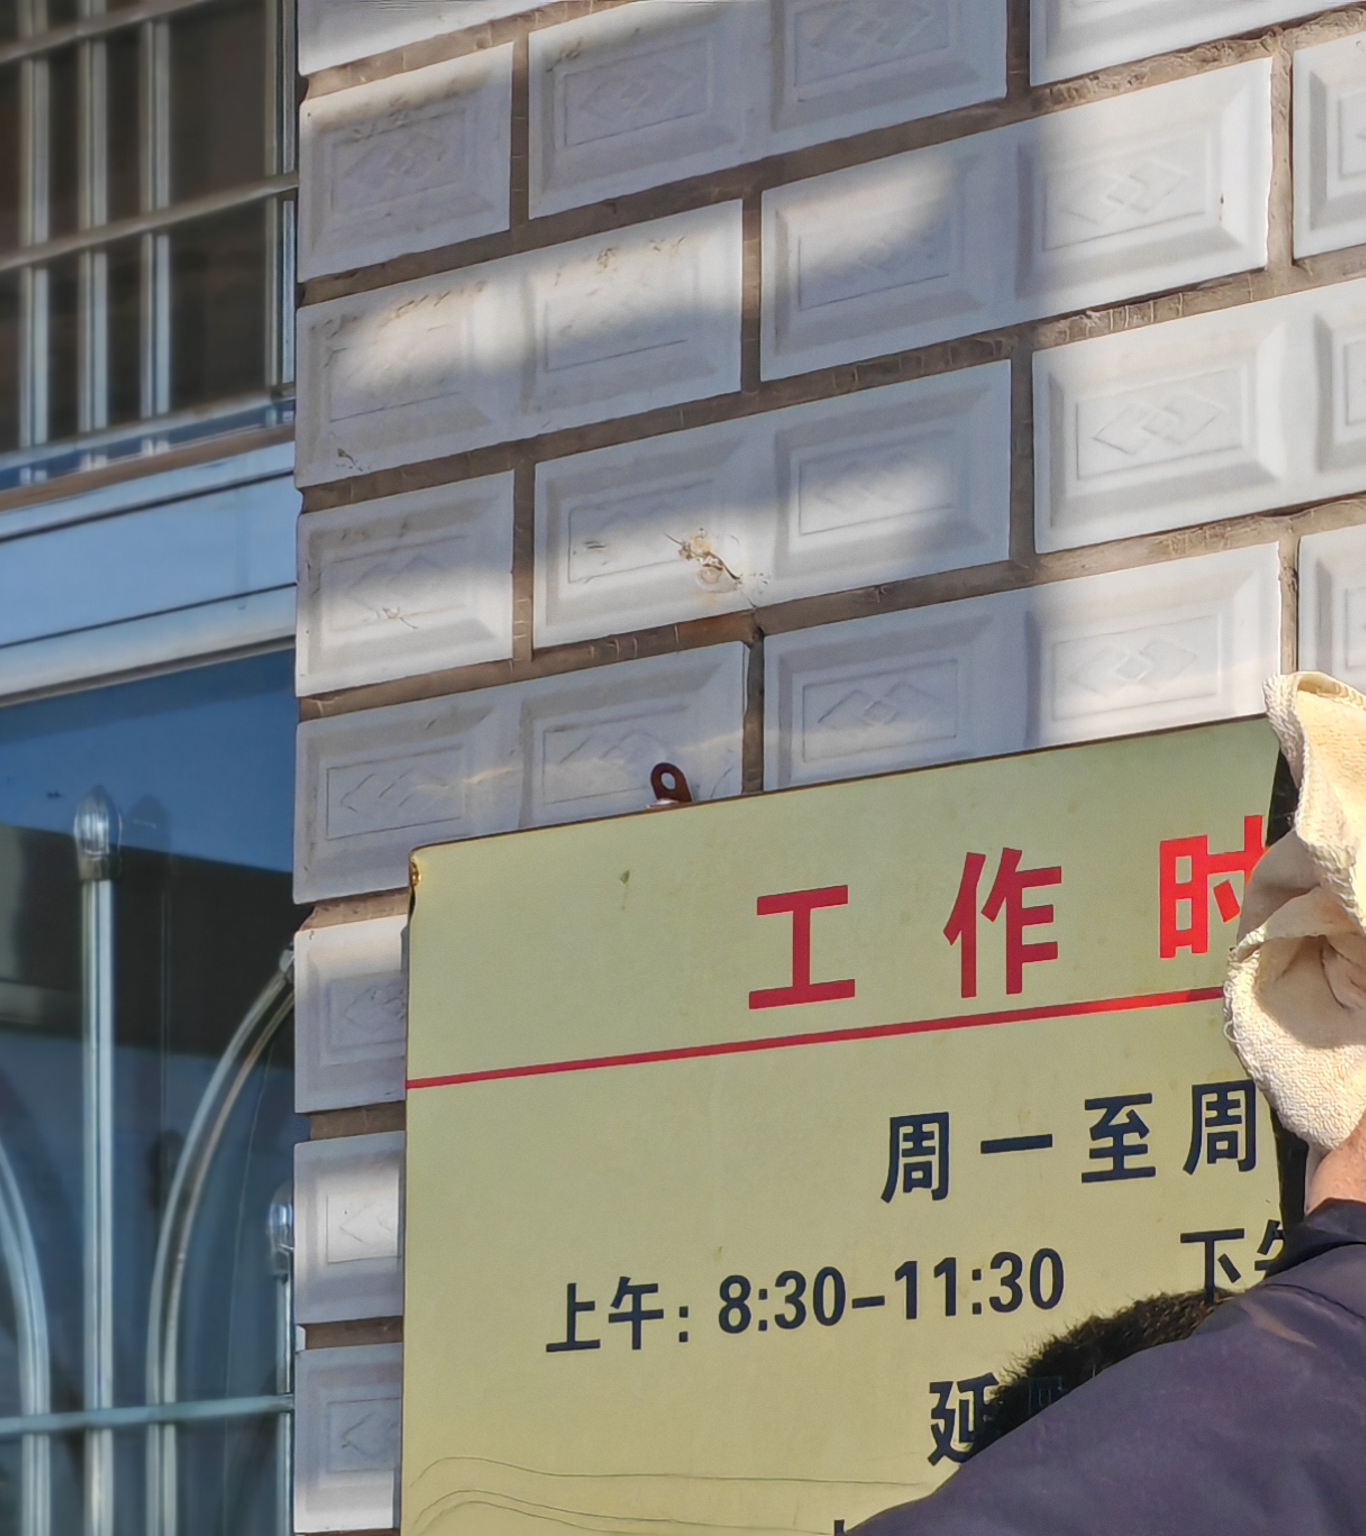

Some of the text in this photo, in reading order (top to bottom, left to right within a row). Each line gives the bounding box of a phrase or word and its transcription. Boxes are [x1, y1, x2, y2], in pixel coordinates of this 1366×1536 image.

[748, 814, 1270, 1010] 工作时
[881, 1079, 1257, 1204] 周一至周
